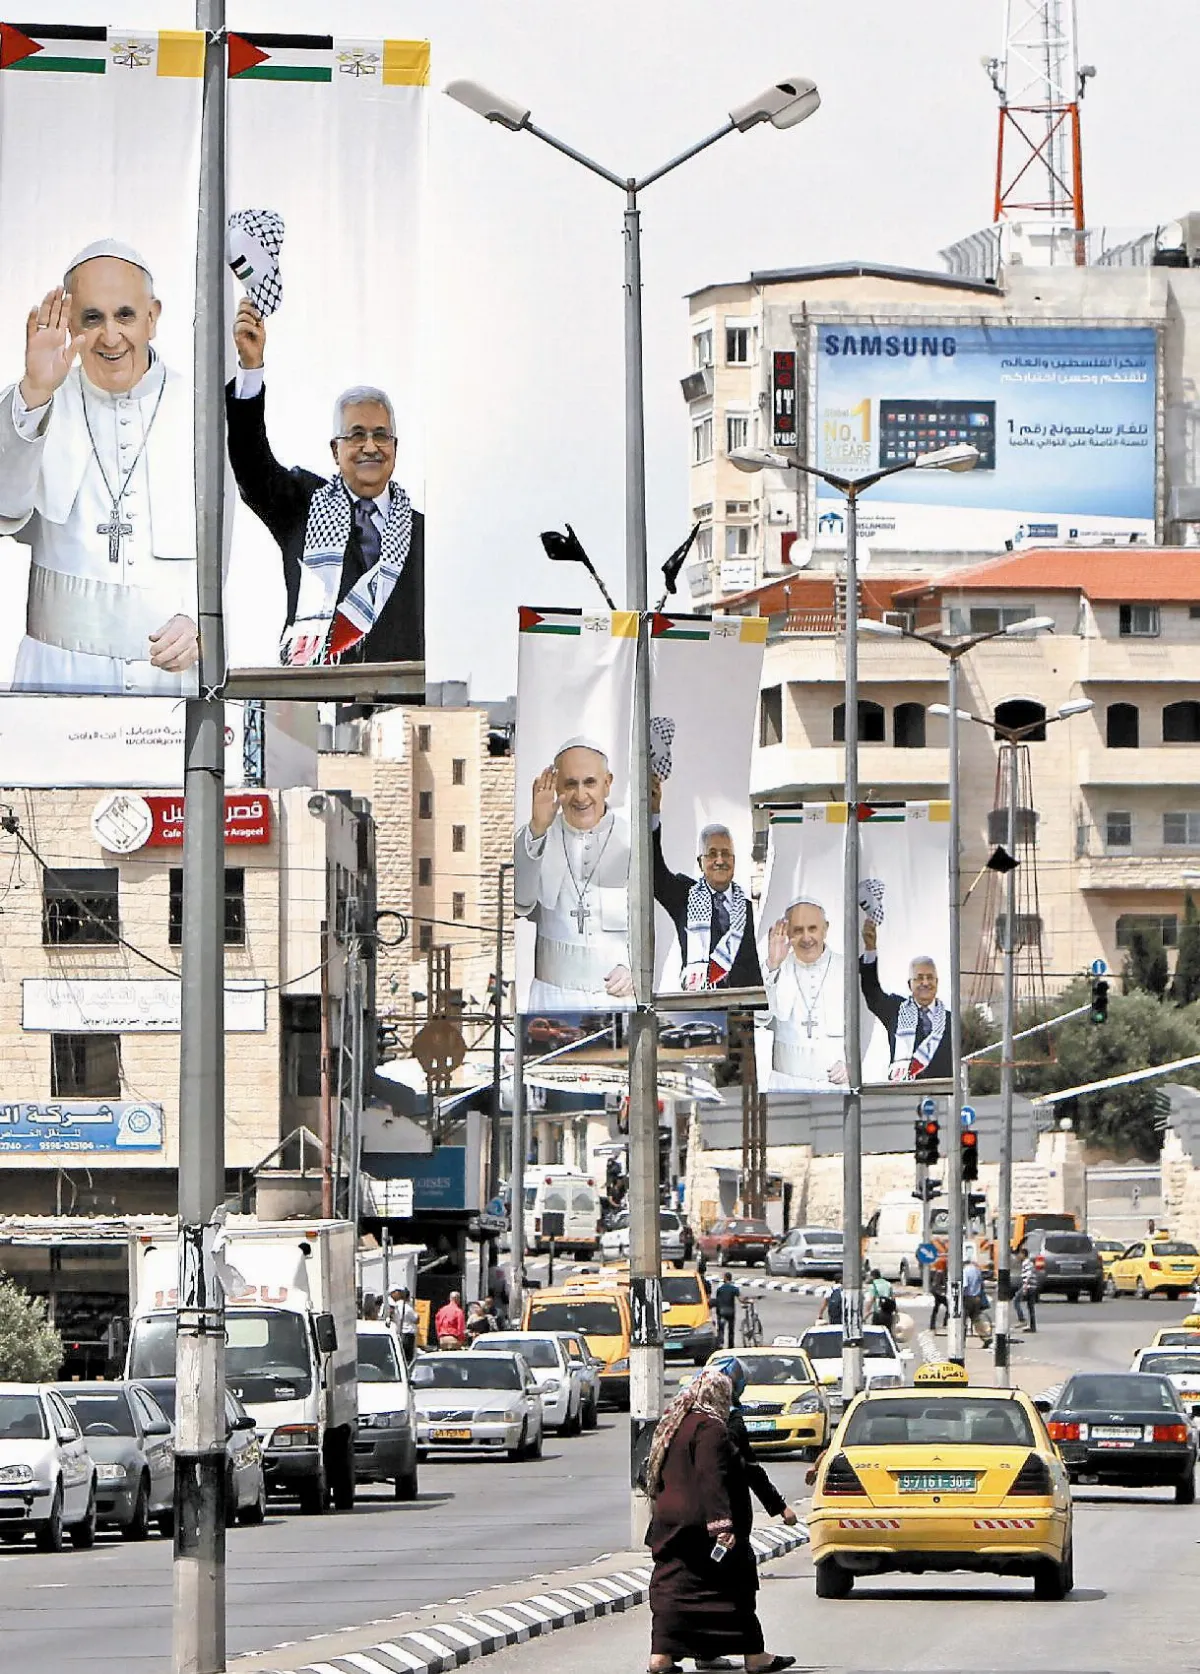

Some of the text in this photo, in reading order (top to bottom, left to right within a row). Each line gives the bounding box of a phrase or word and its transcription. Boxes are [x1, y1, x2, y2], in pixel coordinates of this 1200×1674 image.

[825, 334, 957, 357] SAMSUNG
[1007, 419, 1014, 433] 1
[1020, 423, 1047, 436] رقم
[226, 801, 263, 822] قصر
[163, 829, 181, 838] Cafe
[231, 827, 264, 838] Arageel
[27, 1104, 114, 1127] شركة
